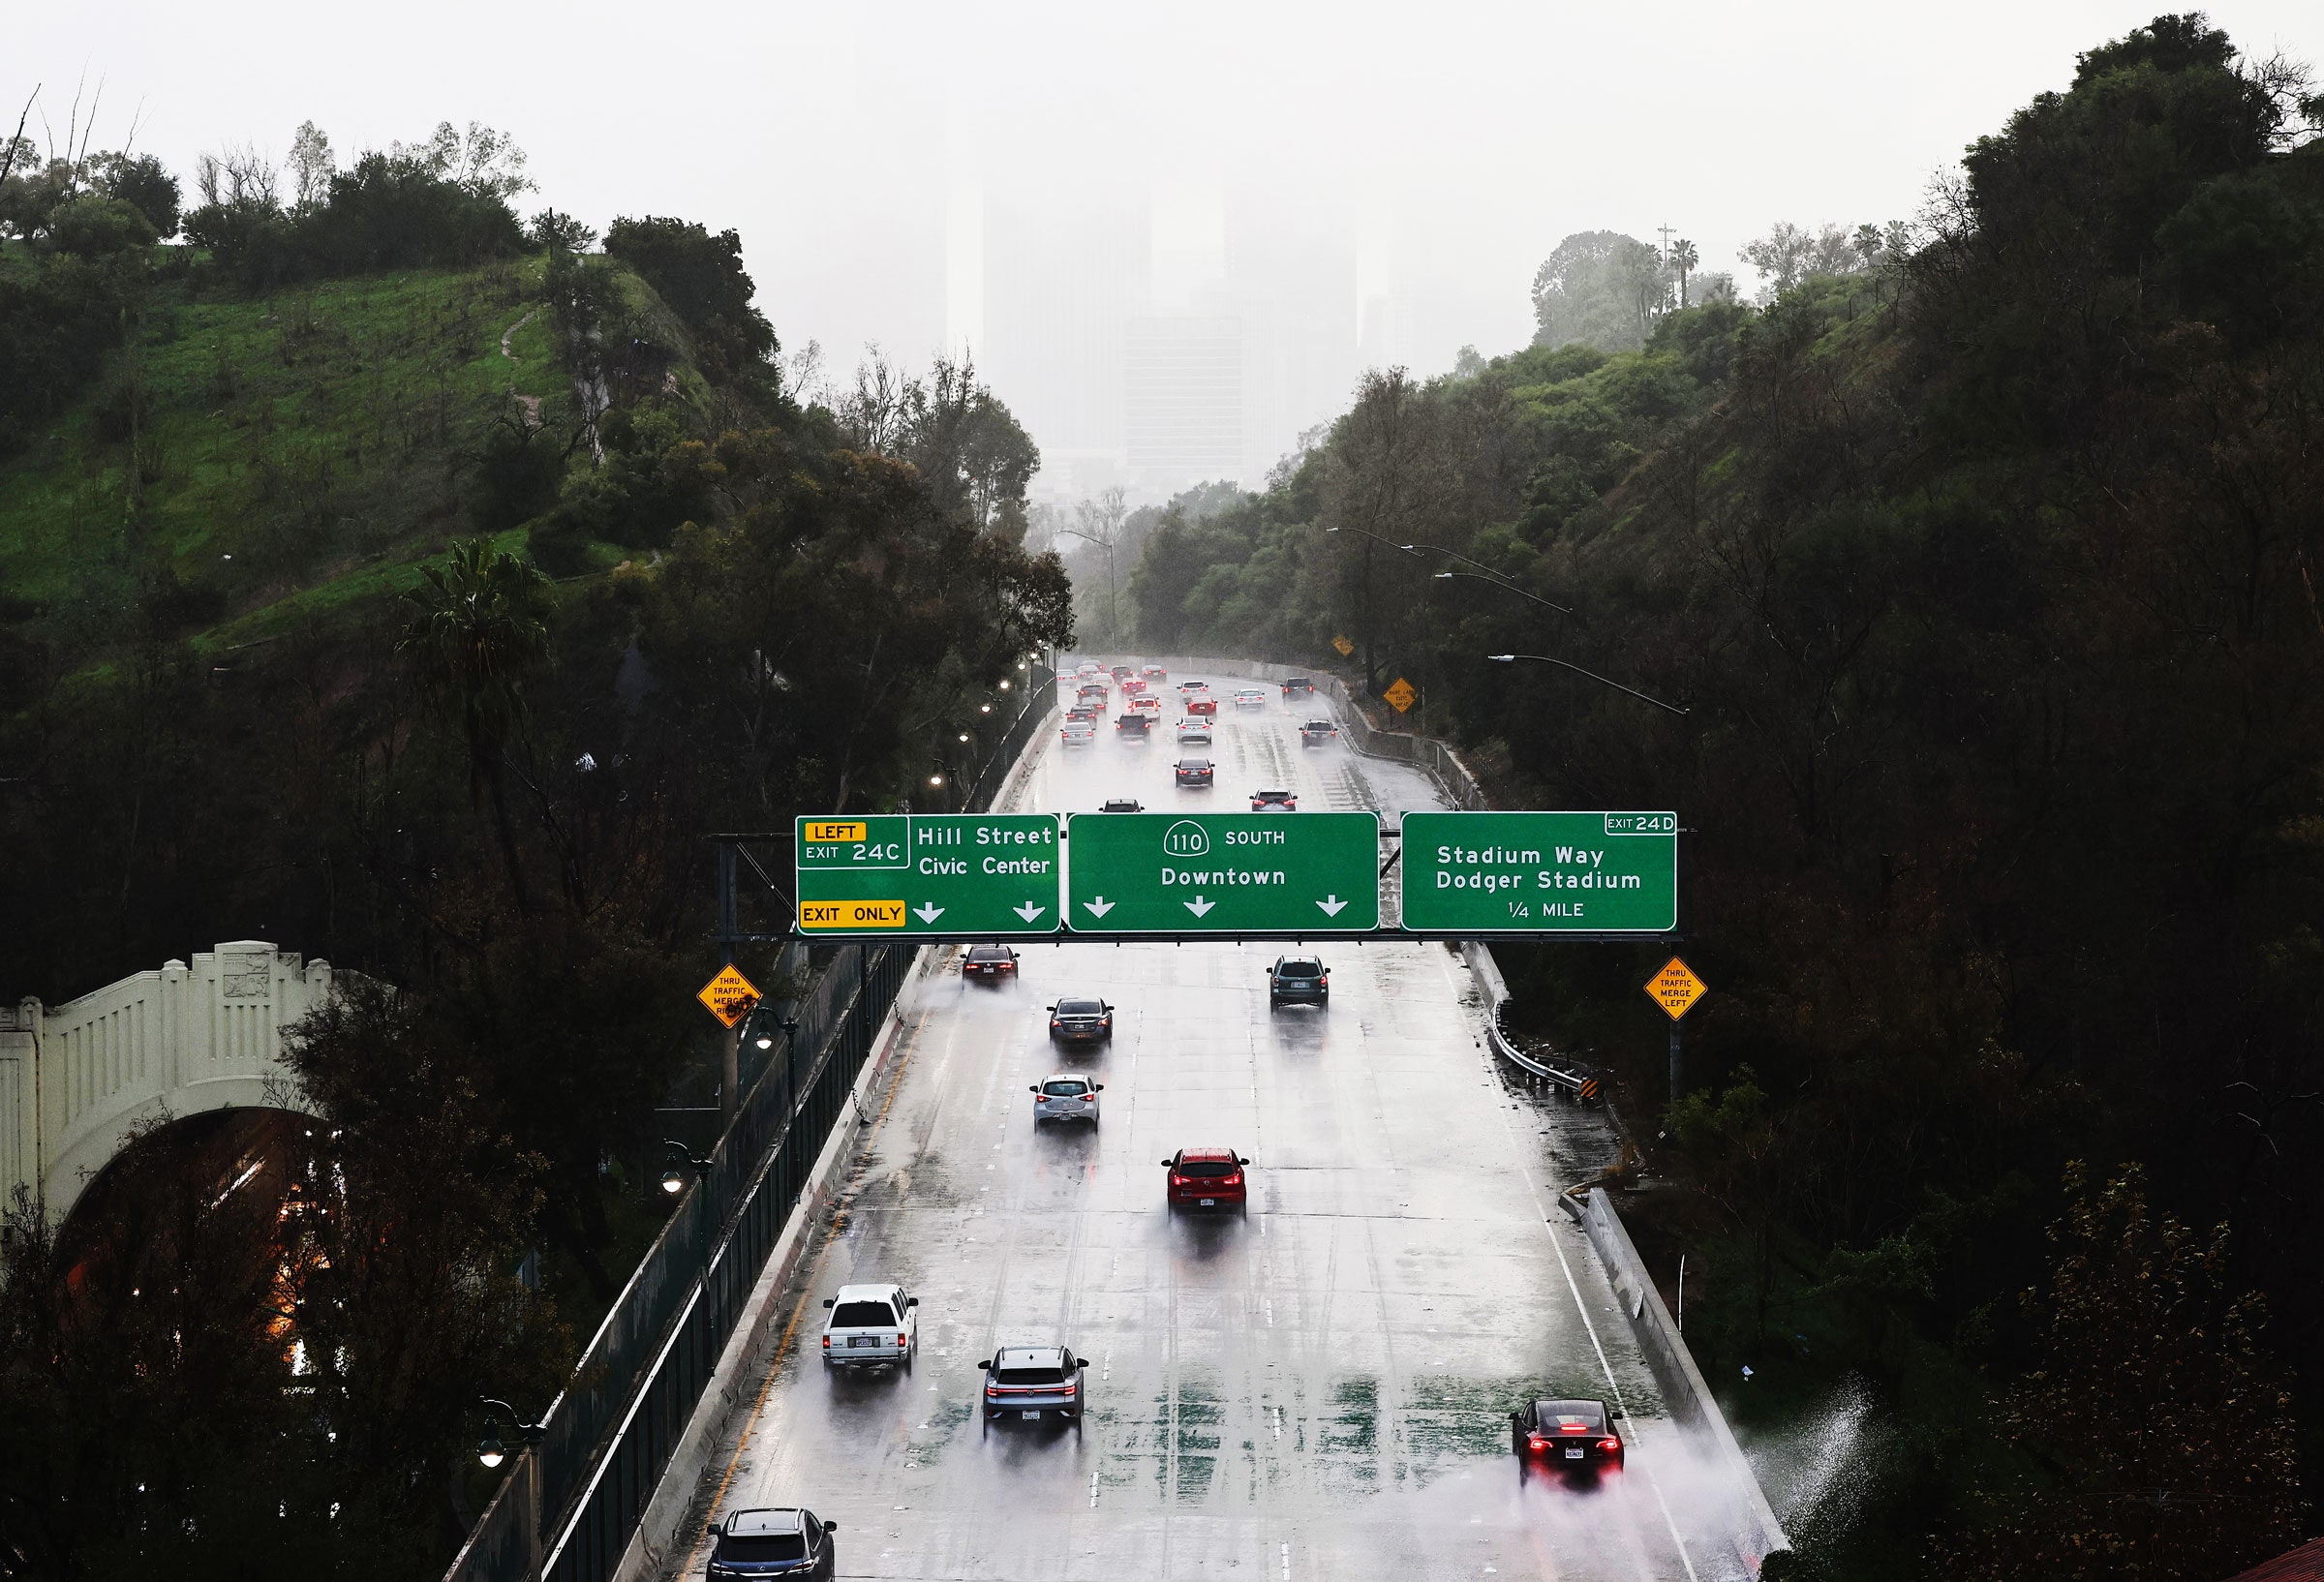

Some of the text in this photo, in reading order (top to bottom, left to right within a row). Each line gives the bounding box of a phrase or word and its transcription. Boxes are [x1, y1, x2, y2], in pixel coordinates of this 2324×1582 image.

[1607, 818, 1634, 829] EXIT
[814, 826, 856, 839] LEFT
[918, 827, 1052, 845] Hill Street
[1225, 831, 1285, 845] SOUTH
[1173, 834, 1202, 851] 110
[806, 843, 900, 861] EXIT 24C
[1437, 845, 1605, 867] Stadium Way
[919, 857, 1050, 875] Civic Center
[1161, 867, 1286, 886] Downtown
[1437, 871, 1641, 894] Dodger Stadium
[803, 907, 902, 921] EXIT ONLY
[1543, 902, 1584, 917] MILE
